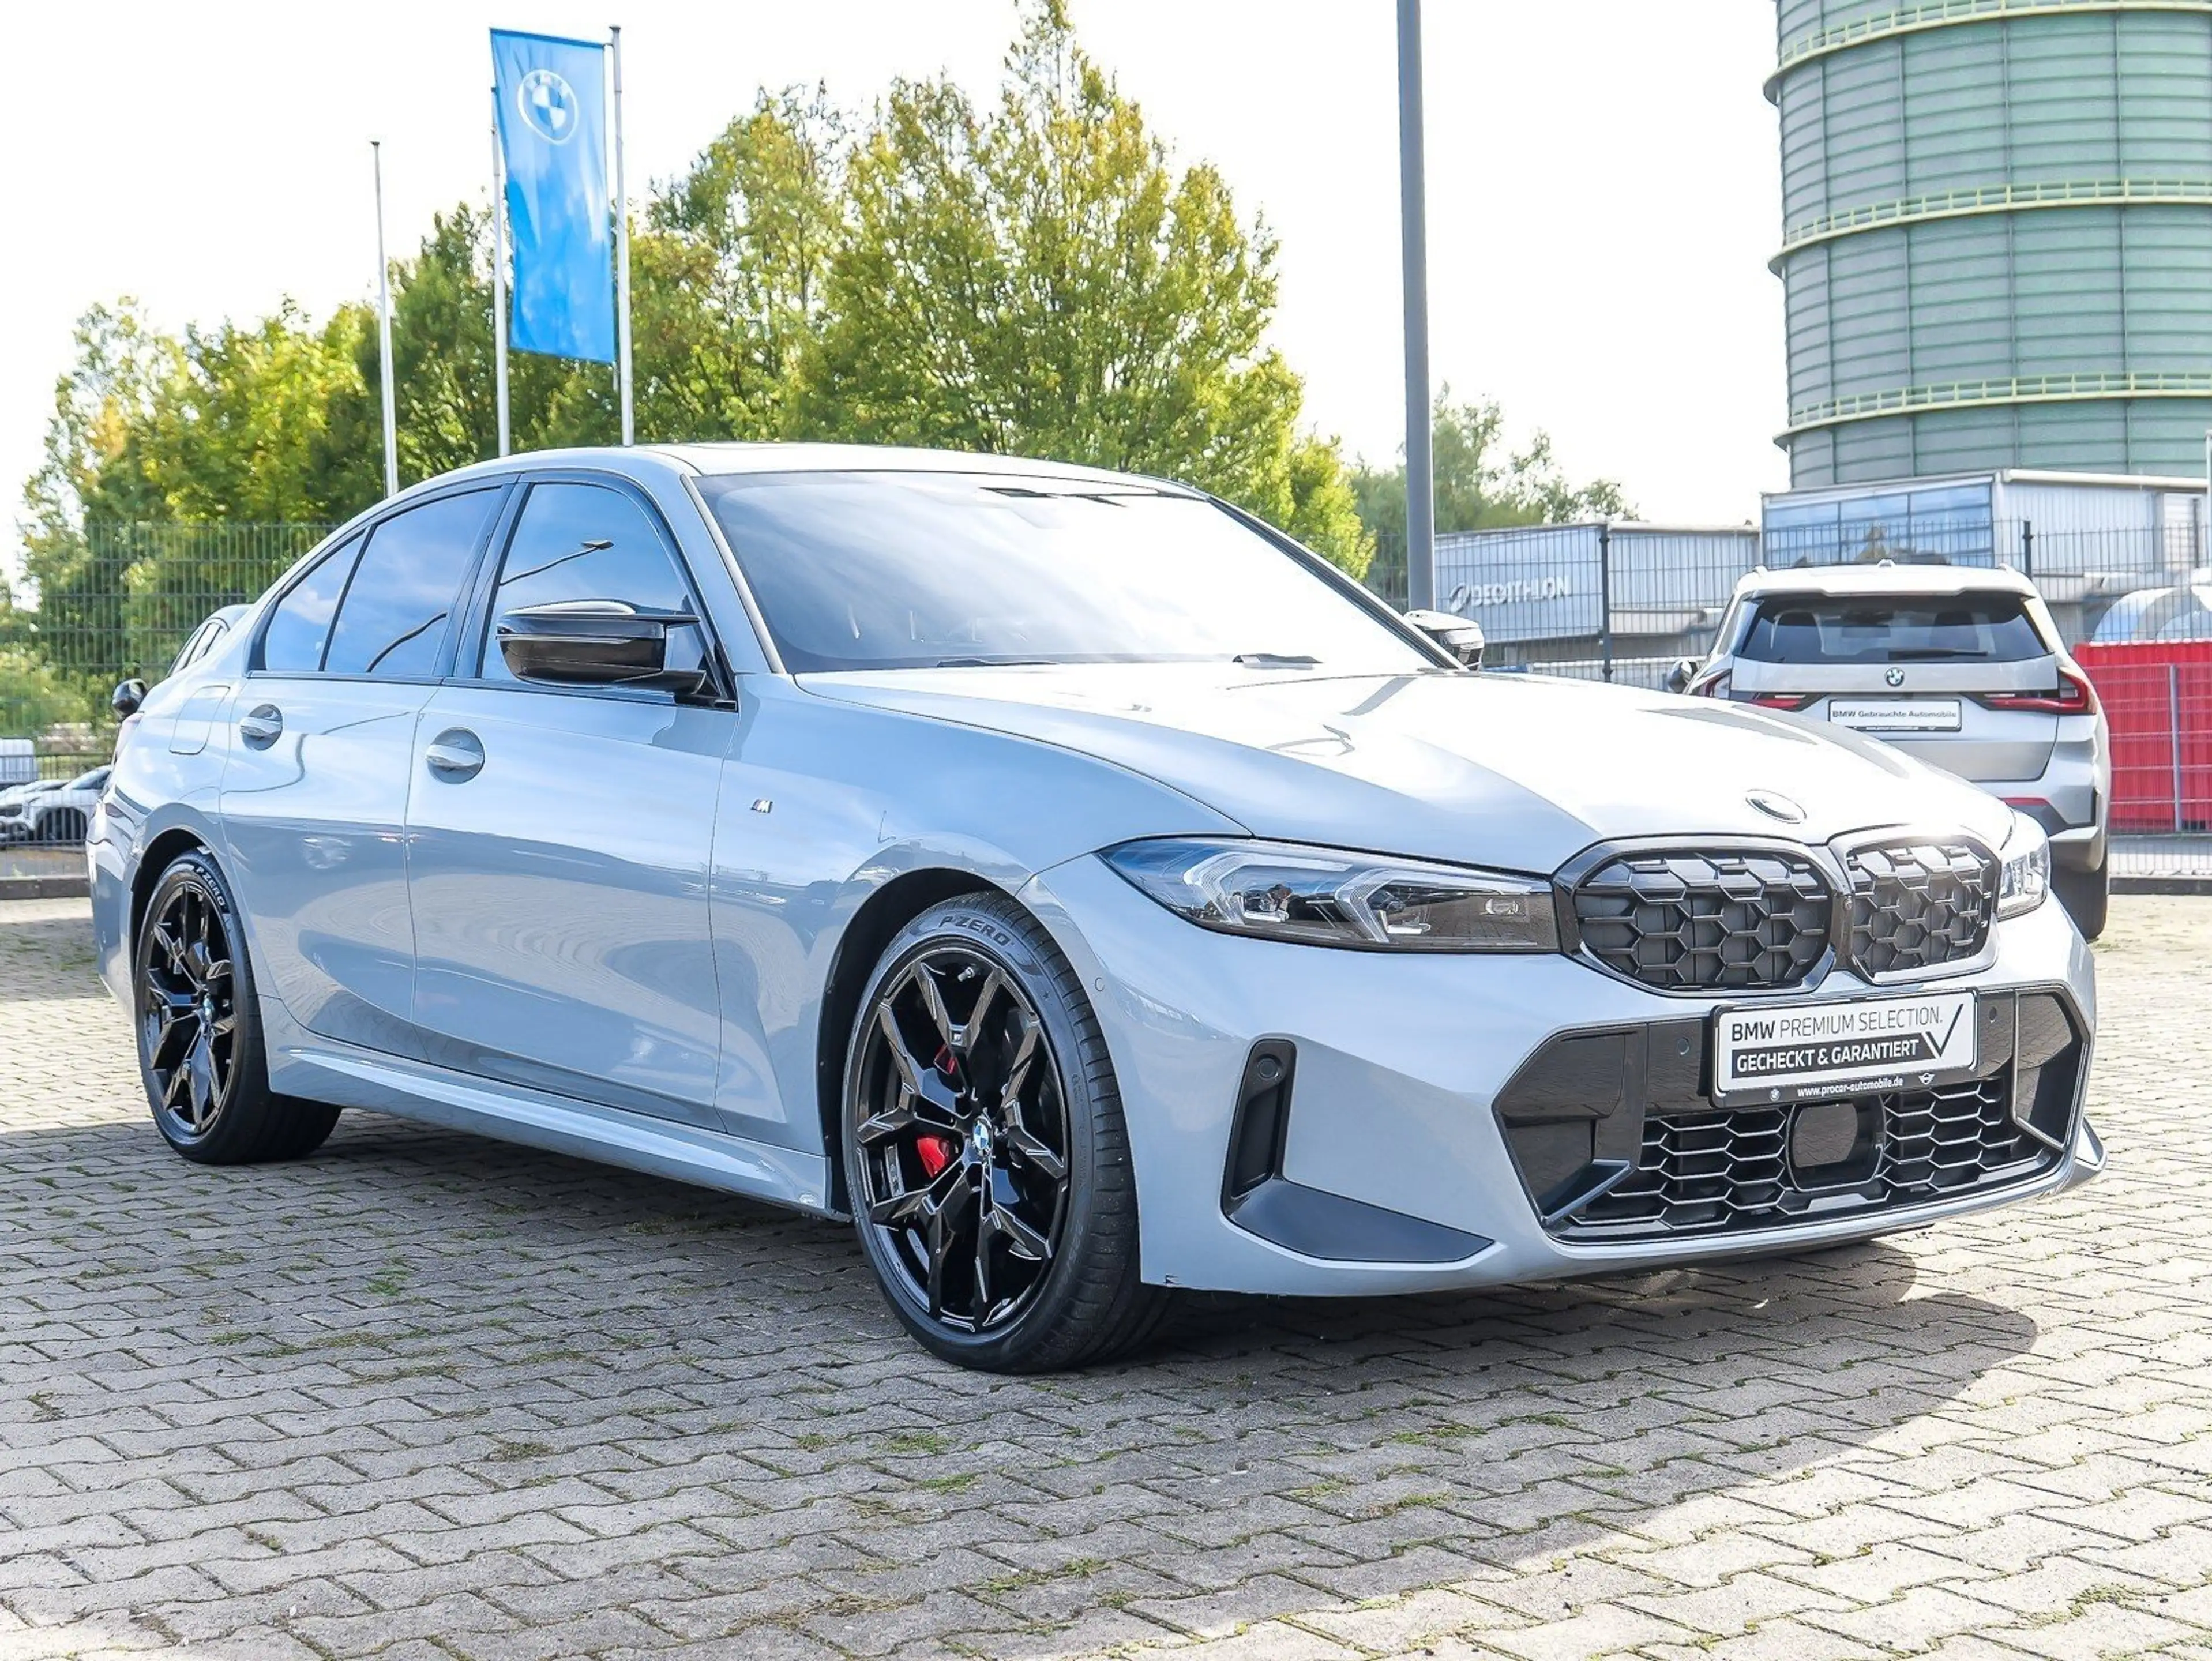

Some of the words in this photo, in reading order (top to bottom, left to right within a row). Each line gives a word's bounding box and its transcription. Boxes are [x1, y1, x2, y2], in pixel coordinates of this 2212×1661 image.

[1858, 709, 1906, 717] Gebrauchte
[1909, 709, 1956, 717] Automobile
[1732, 1020, 1775, 1042] BMW
[1779, 1014, 1854, 1038] PREMIUM
[1859, 1006, 1943, 1031] SELECTION.
[1737, 1049, 1815, 1073] GECHECKT
[1817, 1047, 1830, 1065] &
[1831, 1039, 1920, 1065] GARANTIERT
[1797, 1076, 1903, 1097] www.procar-automobile.de
